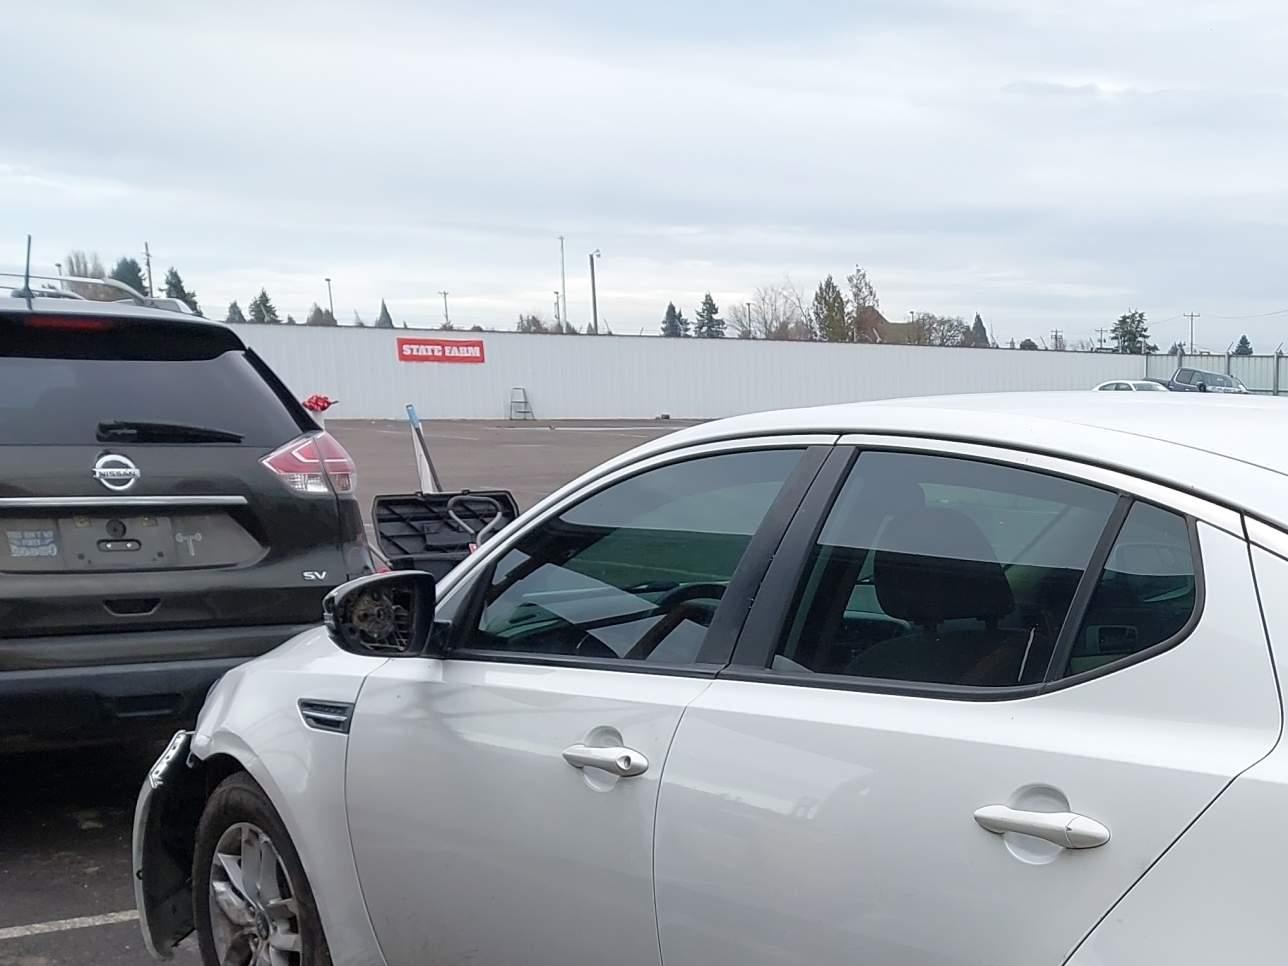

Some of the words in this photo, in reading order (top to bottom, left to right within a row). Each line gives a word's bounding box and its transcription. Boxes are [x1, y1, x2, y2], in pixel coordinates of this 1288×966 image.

[402, 344, 443, 357] STATE
[444, 345, 481, 357] FARM
[99, 470, 136, 478] NISSAN
[303, 571, 327, 580] SV
